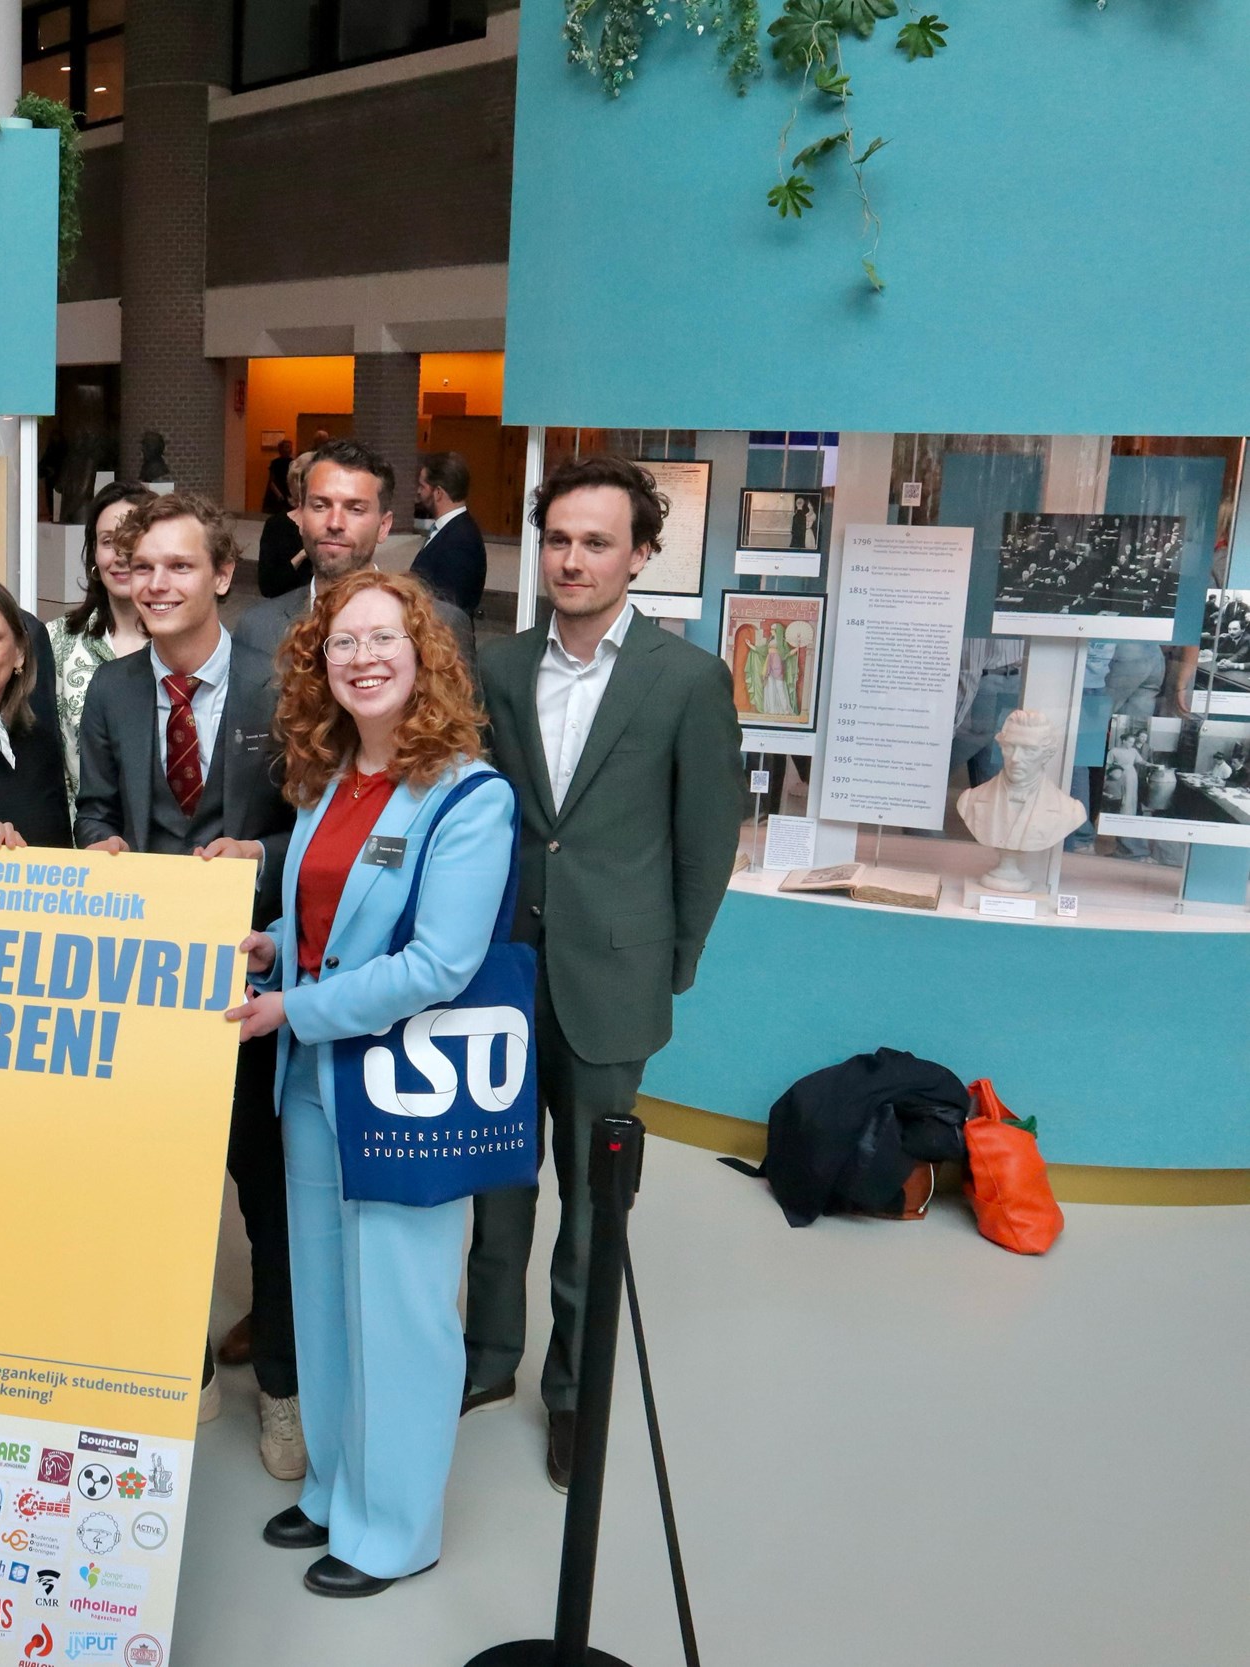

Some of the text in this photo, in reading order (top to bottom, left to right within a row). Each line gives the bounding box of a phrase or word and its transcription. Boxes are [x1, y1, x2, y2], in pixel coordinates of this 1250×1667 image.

[752, 600, 818, 610] VROUWEN
[730, 609, 816, 620] KIESRECHT
[26, 864, 90, 888] weer
[364, 1122, 524, 1142] INTERSTEDELIJK
[364, 1138, 525, 1158] STUDENTEN OVERLEG
[72, 1374, 188, 1402] studentbestuur
[80, 1434, 137, 1452] SoundLab
[31, 1533, 58, 1542] Studenten
[30, 1540, 60, 1550] Organisatie
[28, 1546, 56, 1556] Groningen
[101, 1580, 142, 1590] Democraten
[35, 1597, 60, 1608] CMR
